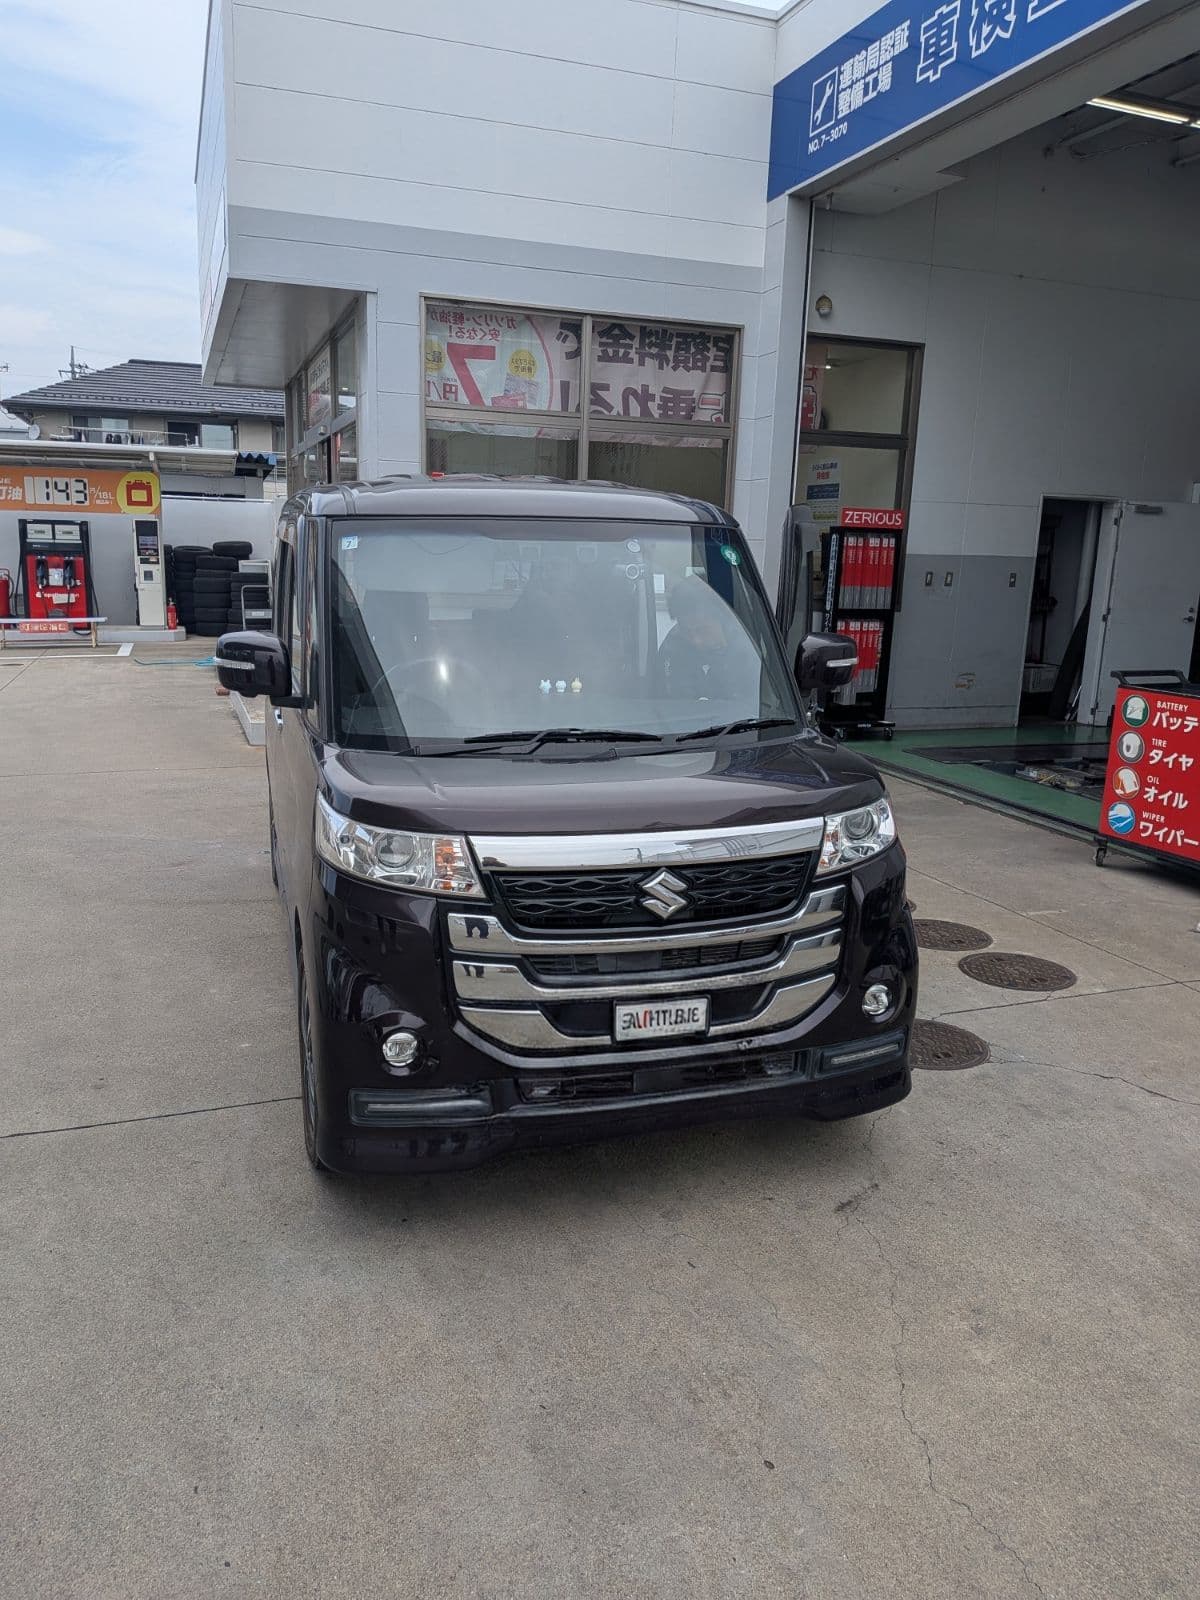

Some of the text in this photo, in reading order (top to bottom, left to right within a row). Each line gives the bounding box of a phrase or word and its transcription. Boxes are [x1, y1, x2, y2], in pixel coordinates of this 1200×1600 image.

[915, 0, 1067, 83] 車検
[839, 19, 911, 90] 運輸局認証
[837, 61, 893, 119] 整備工場
[45, 479, 88, 504] 143
[844, 511, 902, 526] ZERIOUS
[1156, 700, 1189, 713] BATTERY
[1152, 711, 1200, 733] バッテ
[1151, 738, 1168, 748] TIRE
[1148, 749, 1195, 772] タイヤ
[1147, 775, 1160, 785] OIL
[1143, 786, 1189, 810] オイル
[1142, 811, 1165, 824] WIPER
[1139, 822, 1199, 847] ワイパー
